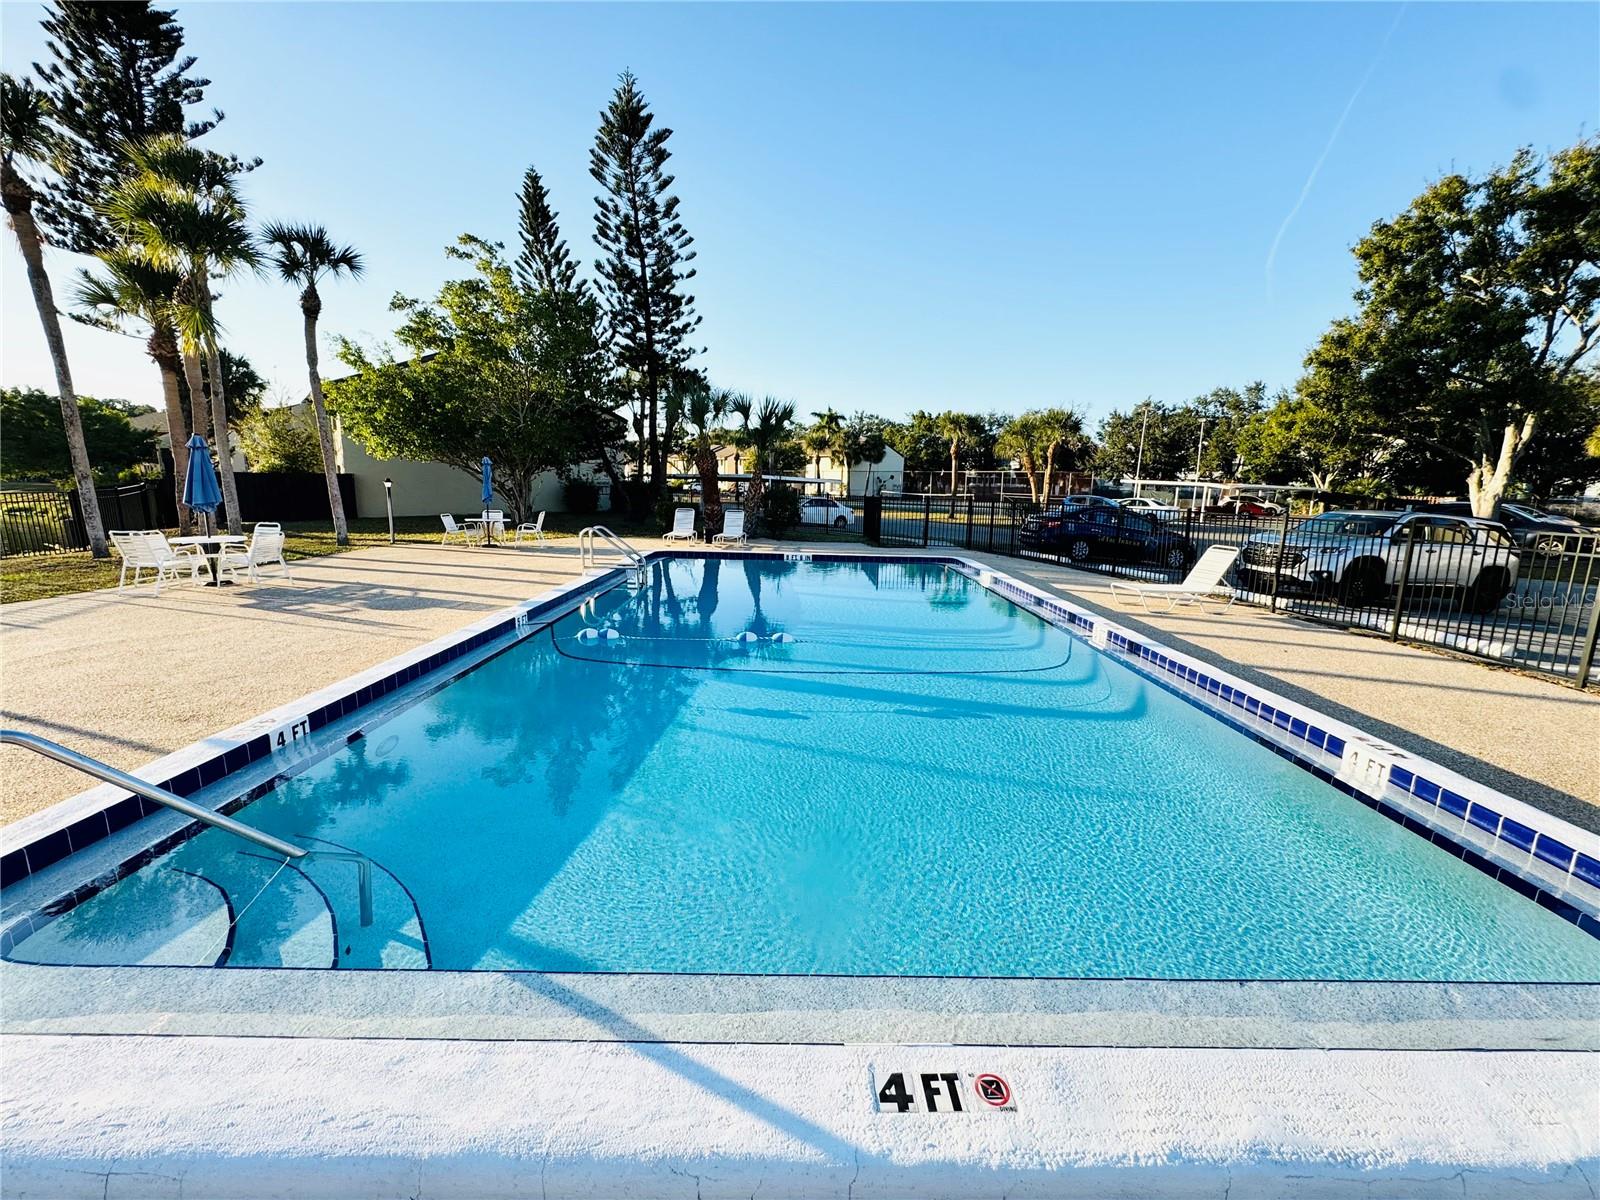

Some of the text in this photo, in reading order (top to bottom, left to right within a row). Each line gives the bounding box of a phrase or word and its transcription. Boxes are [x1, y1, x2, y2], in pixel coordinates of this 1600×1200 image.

[277, 730, 286, 747] 4
[1366, 758, 1386, 778] FT
[879, 1073, 963, 1113] 4 FT
